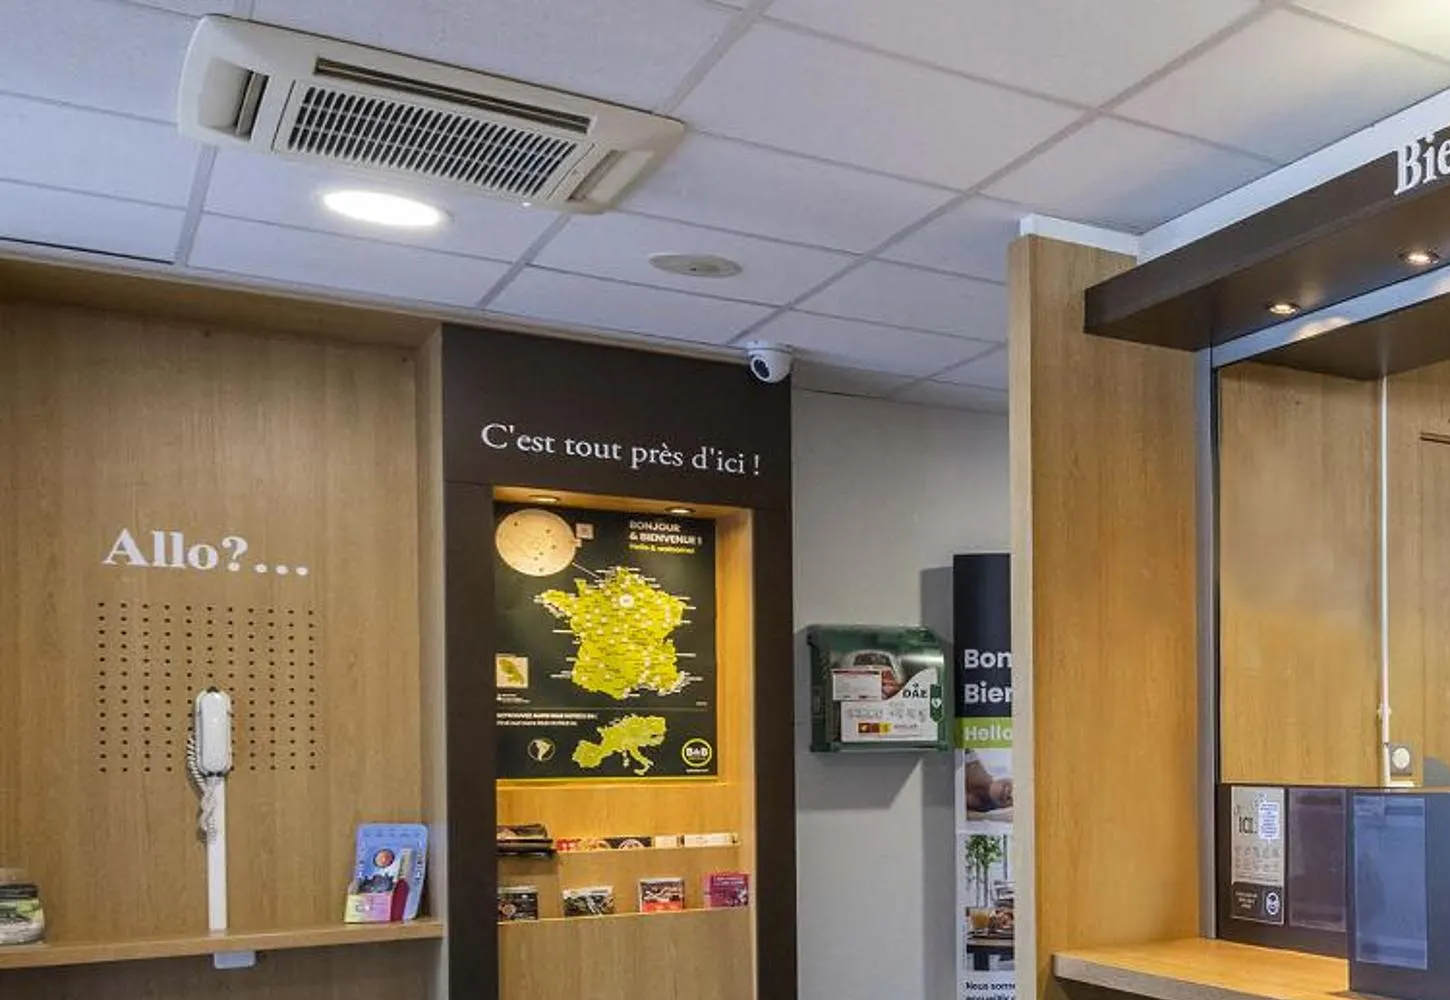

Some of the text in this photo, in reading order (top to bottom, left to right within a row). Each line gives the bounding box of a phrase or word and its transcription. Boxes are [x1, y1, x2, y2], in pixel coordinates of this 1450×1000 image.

[480, 422, 761, 476] C'est tout près d'ici !
[629, 520, 681, 532] BONJOUR
[639, 532, 696, 546] BIENVENUE
[101, 527, 309, 577] Allo?...
